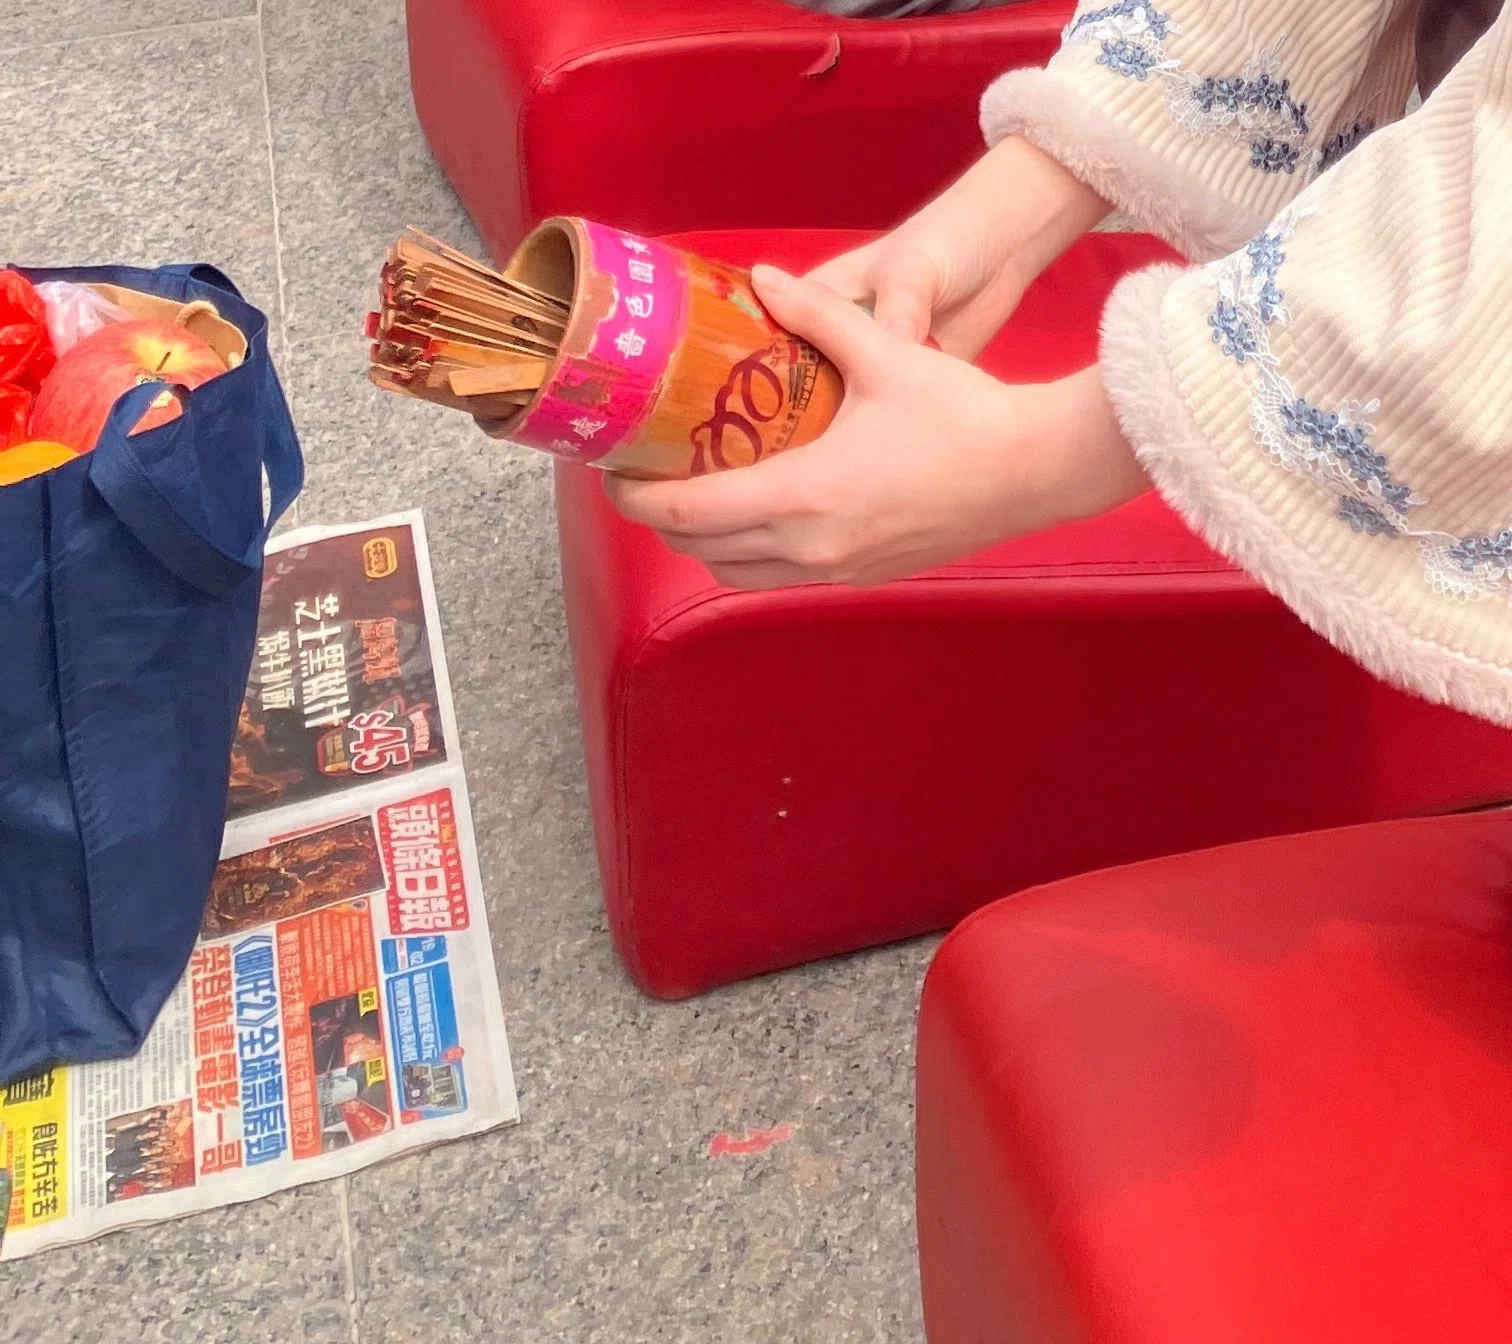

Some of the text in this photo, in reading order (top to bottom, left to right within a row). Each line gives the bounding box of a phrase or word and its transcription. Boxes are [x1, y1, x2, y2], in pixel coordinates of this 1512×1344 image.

[348, 709, 411, 775] $45
[387, 804, 452, 931] 頭條日報
